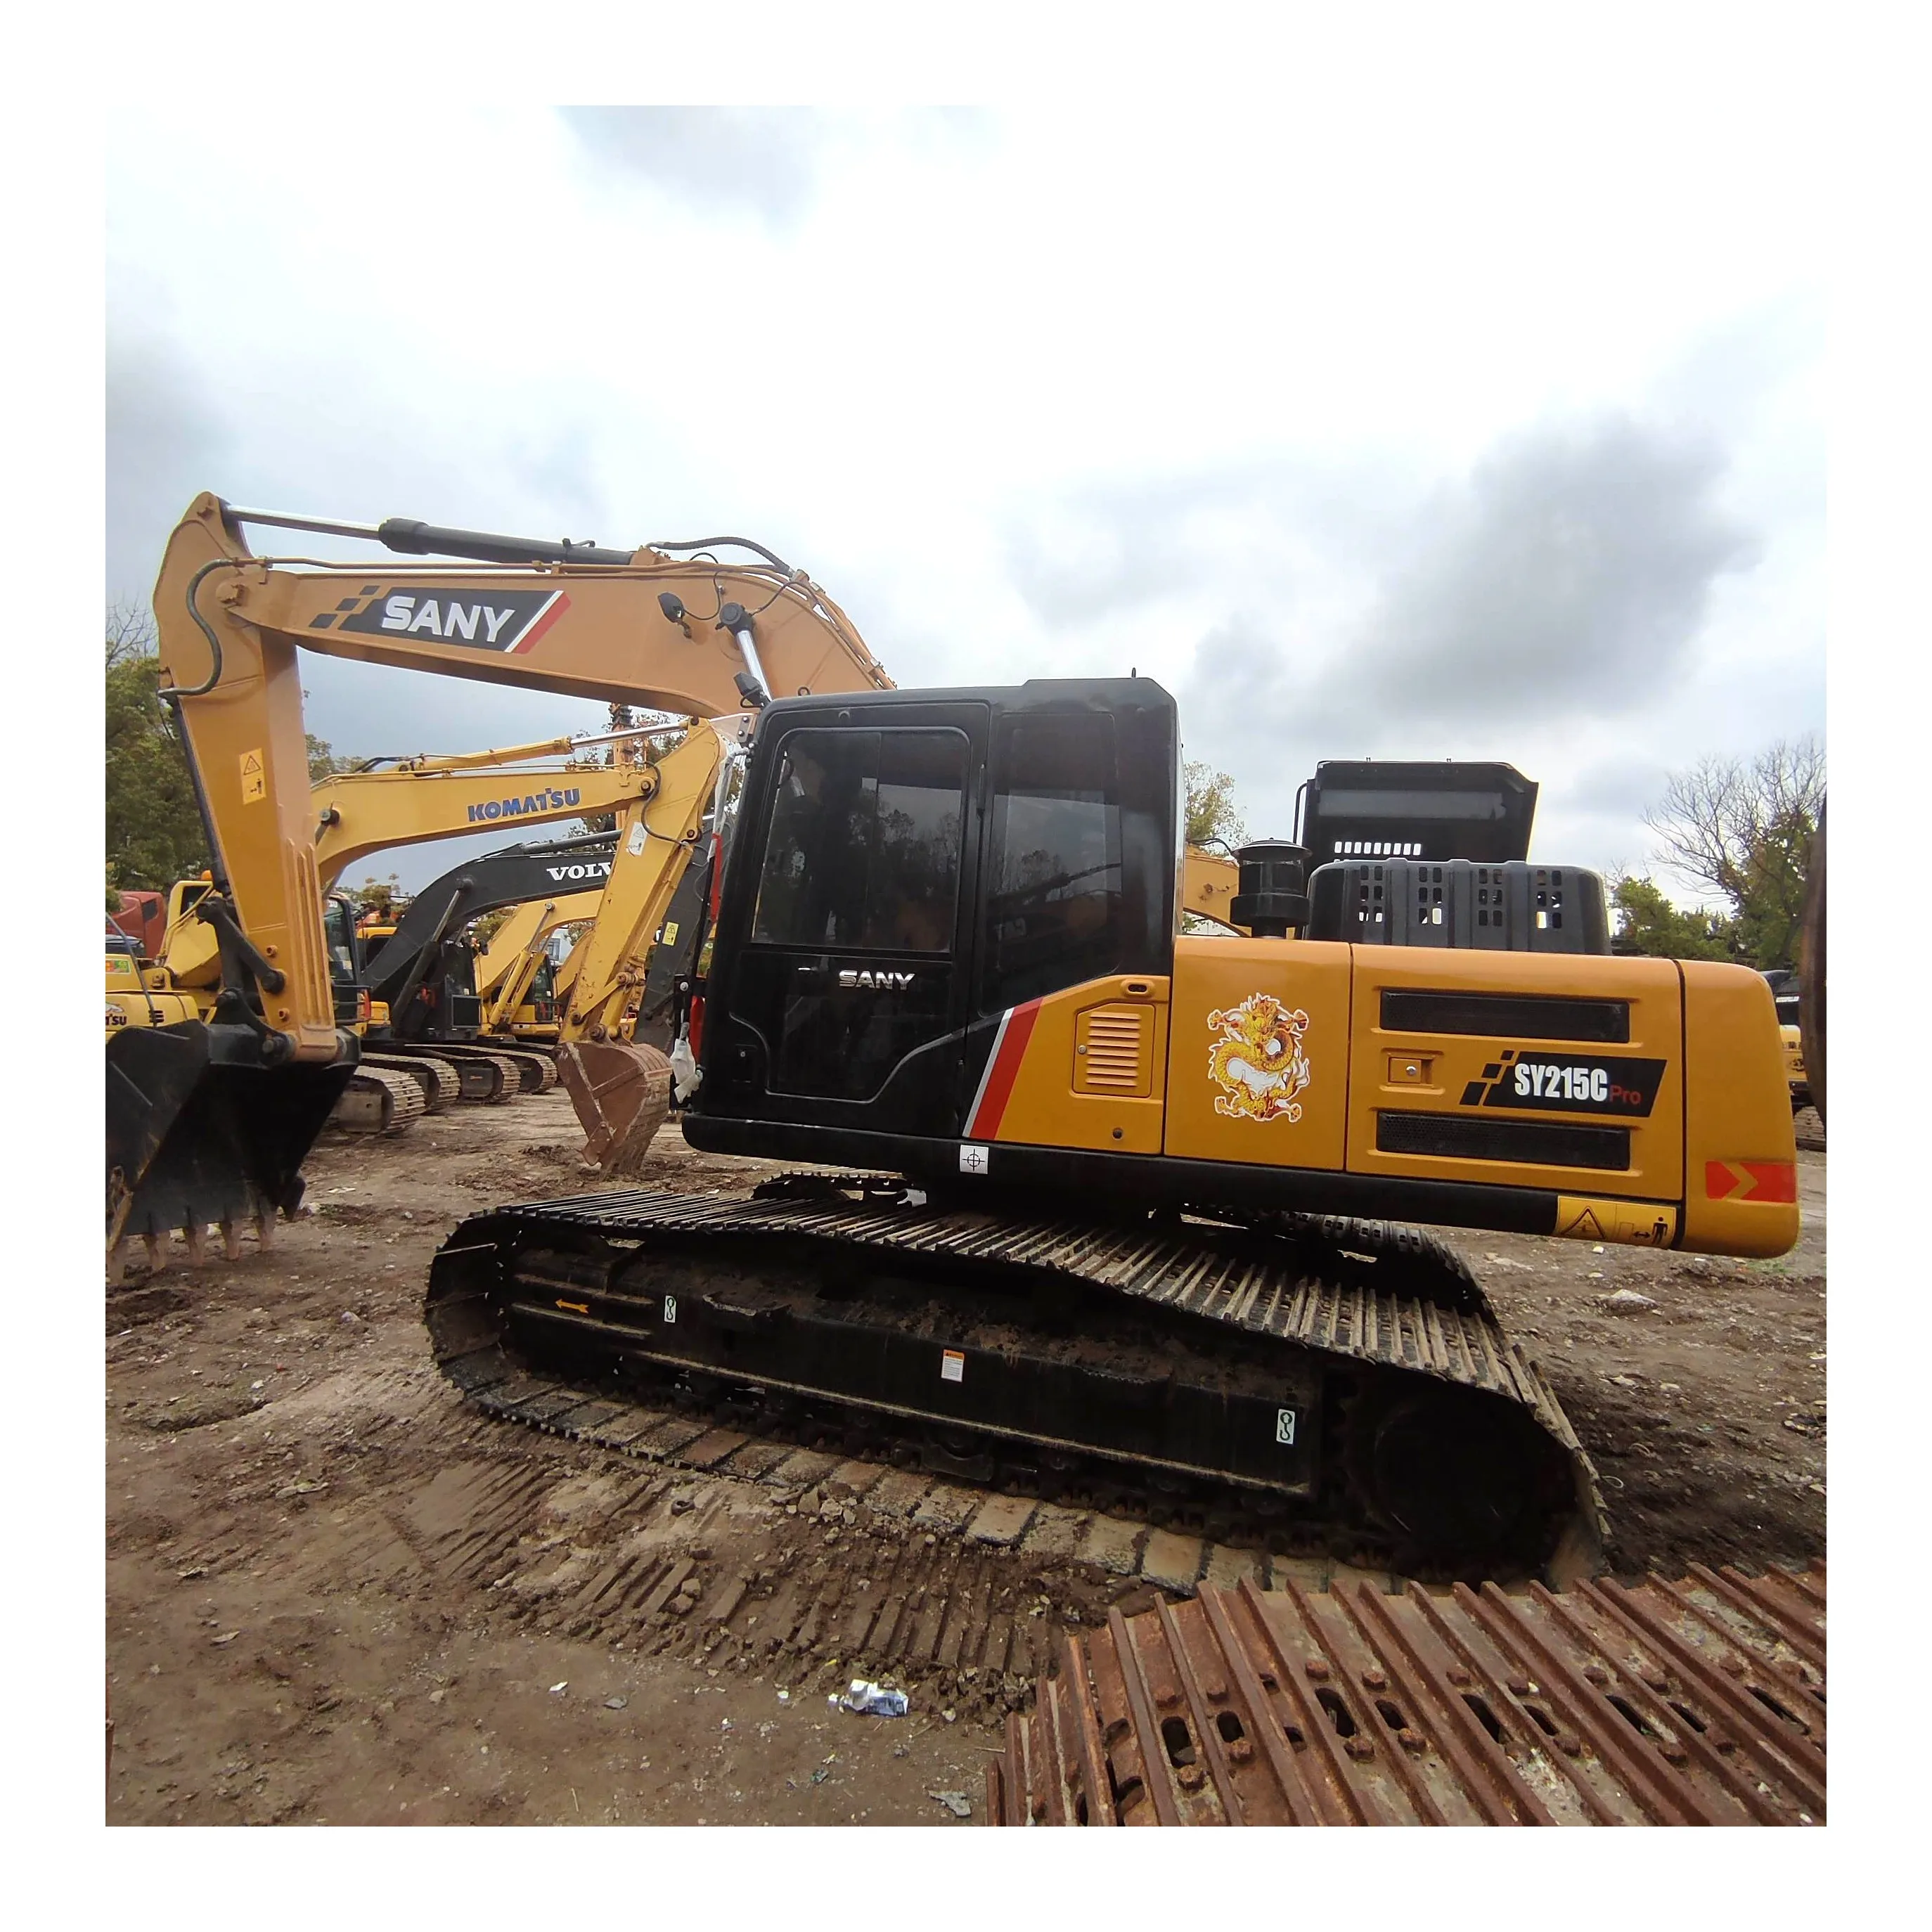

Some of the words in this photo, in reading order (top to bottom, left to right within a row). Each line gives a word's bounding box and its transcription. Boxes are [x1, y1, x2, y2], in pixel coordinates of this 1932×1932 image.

[381, 595, 516, 643] SANY
[468, 787, 581, 823] KOMATSU
[839, 970, 915, 991] SANY
[1514, 1063, 1608, 1102] SY215C
[1609, 1085, 1642, 1105] Pro
